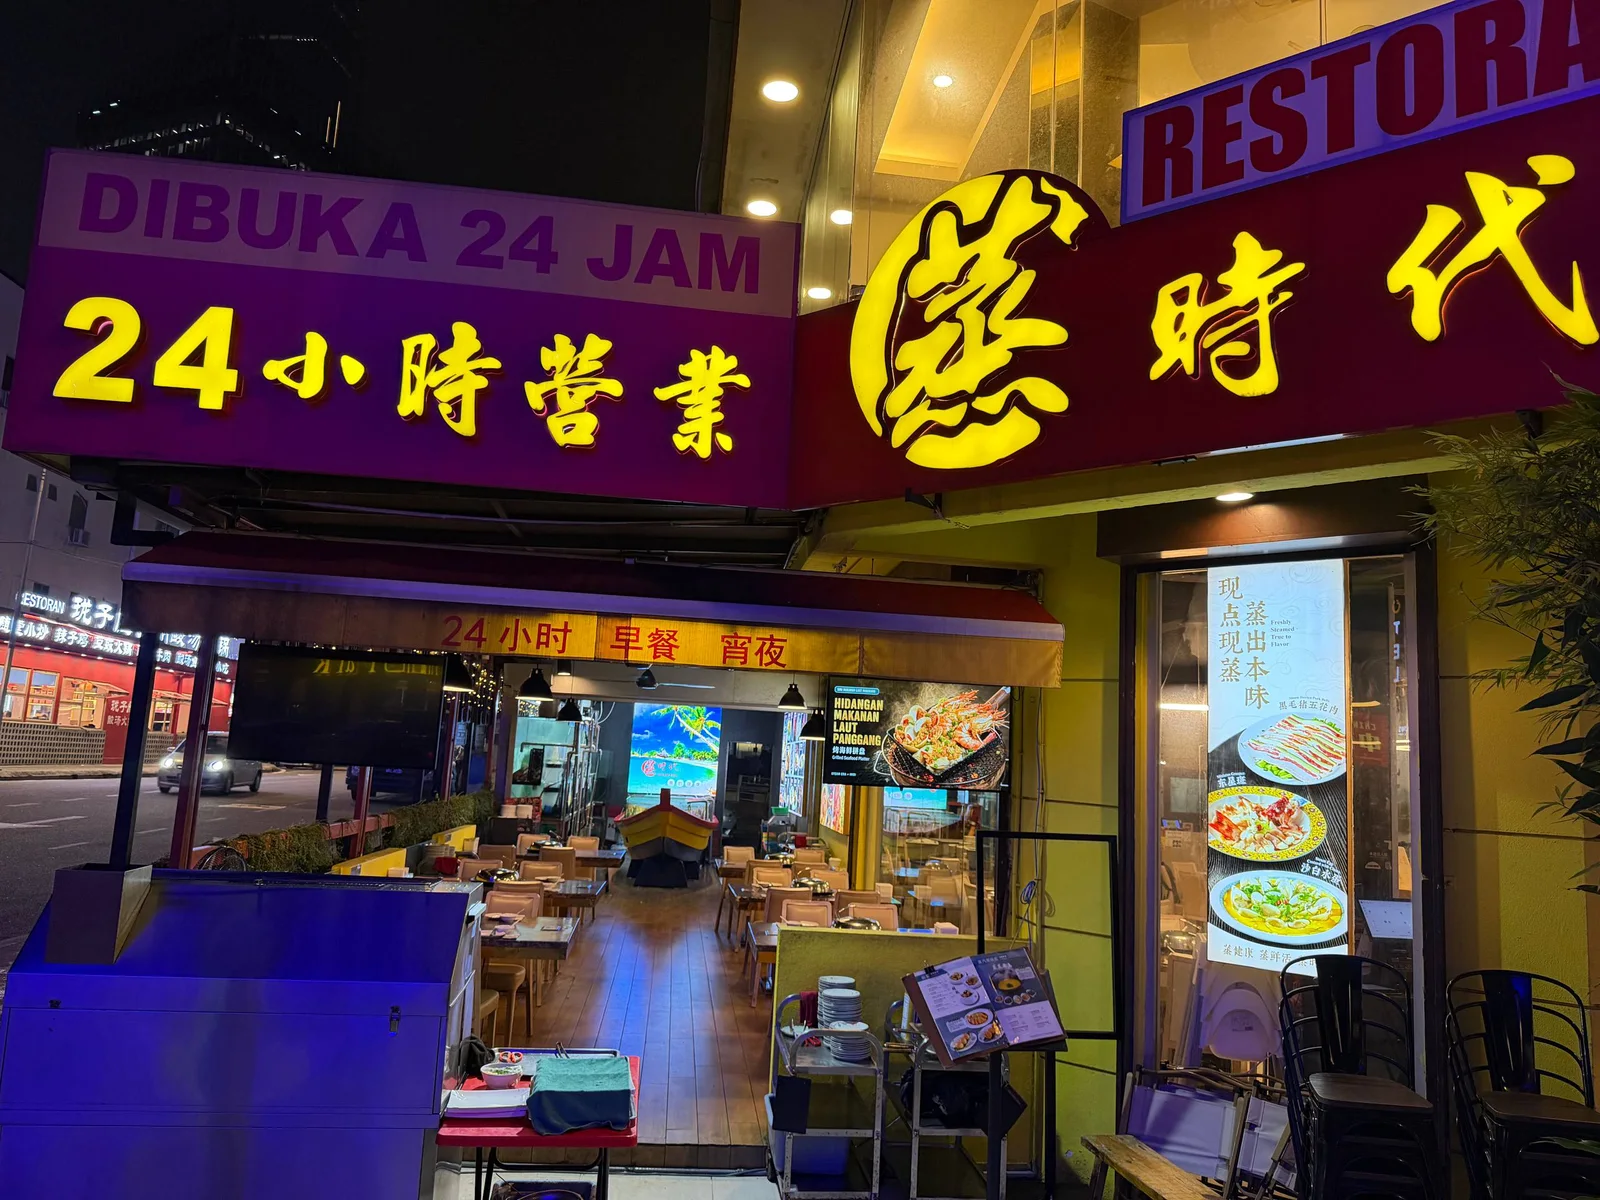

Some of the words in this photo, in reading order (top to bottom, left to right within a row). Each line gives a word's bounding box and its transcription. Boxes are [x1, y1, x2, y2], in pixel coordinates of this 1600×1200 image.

[78, 172, 427, 262] DIBUKA
[456, 209, 558, 274] 24
[586, 225, 762, 295] JAM
[1218, 576, 1244, 683] 现点现蒸
[610, 625, 680, 662] 早餐
[720, 632, 788, 669] 宵夜
[1244, 600, 1270, 710] 蒸出本味
[833, 709, 880, 723] MAKANAN
[834, 697, 884, 711] HIDANGAN
[832, 733, 882, 746] PANGGANG
[833, 721, 858, 734] LAUT
